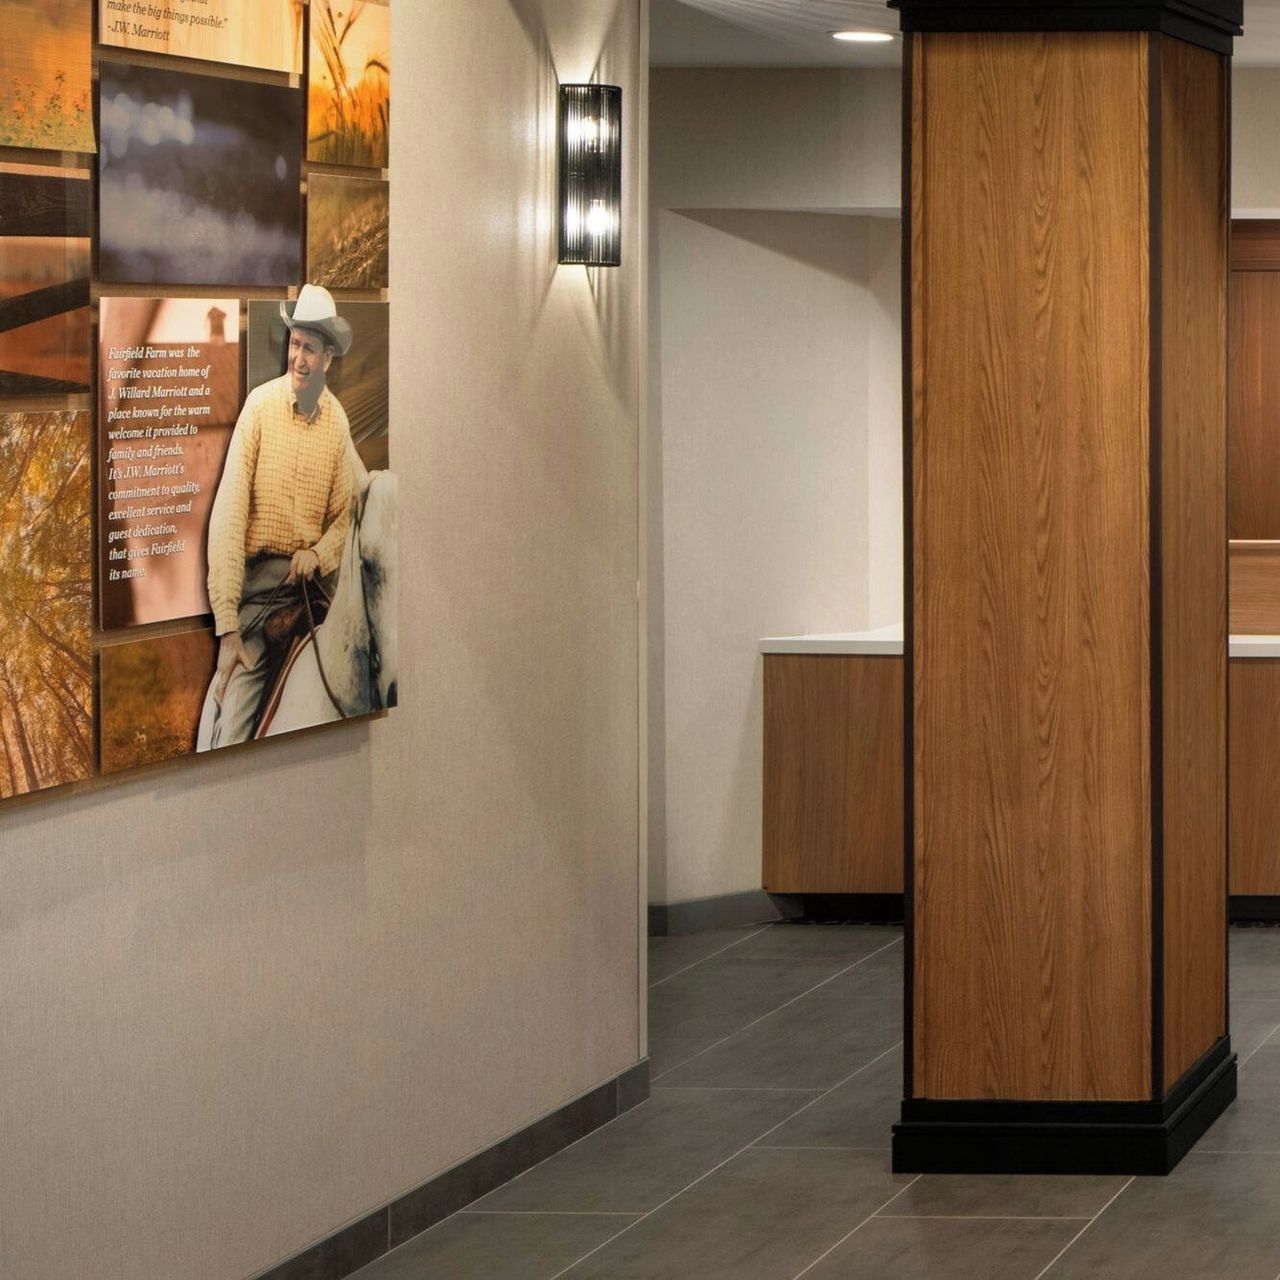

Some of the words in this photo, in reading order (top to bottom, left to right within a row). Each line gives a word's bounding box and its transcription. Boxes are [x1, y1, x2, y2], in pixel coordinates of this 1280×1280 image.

[107, 0, 130, 12] make
[133, 2, 146, 15] the
[148, 4, 162, 20] big
[163, 8, 189, 25] things
[132, 24, 170, 40] Marriott
[108, 347, 144, 361] Fairfield
[145, 347, 167, 358] Farm
[169, 350, 184, 358] was
[187, 346, 200, 357] the
[106, 368, 141, 382] favorite
[142, 366, 177, 378] vacation
[179, 366, 200, 377] home
[200, 365, 211, 379] of
[108, 388, 116, 400] J.
[119, 386, 151, 398] Willard
[152, 386, 187, 398] Marriott
[189, 385, 204, 396] and
[108, 408, 131, 422] place
[132, 407, 158, 418] known
[159, 405, 172, 419] for
[174, 405, 186, 416] the
[188, 406, 210, 415] warm
[108, 427, 144, 440] welcome
[145, 426, 152, 438] it
[153, 424, 188, 439] provided
[189, 425, 198, 434] to
[107, 447, 135, 462] family
[137, 446, 154, 458] and
[152, 444, 184, 459] friends.
[109, 468, 122, 480] It's
[124, 466, 141, 478] J.W.
[143, 463, 184, 477] Marriott's
[108, 486, 159, 500] commitment
[162, 485, 169, 495] to
[108, 507, 145, 520] excellent
[146, 504, 175, 515] service
[176, 501, 192, 512] and
[108, 528, 131, 543] guest
[109, 548, 126, 560] that
[128, 546, 149, 560] gives
[150, 540, 185, 556] Fairfield
[109, 570, 120, 580] its
